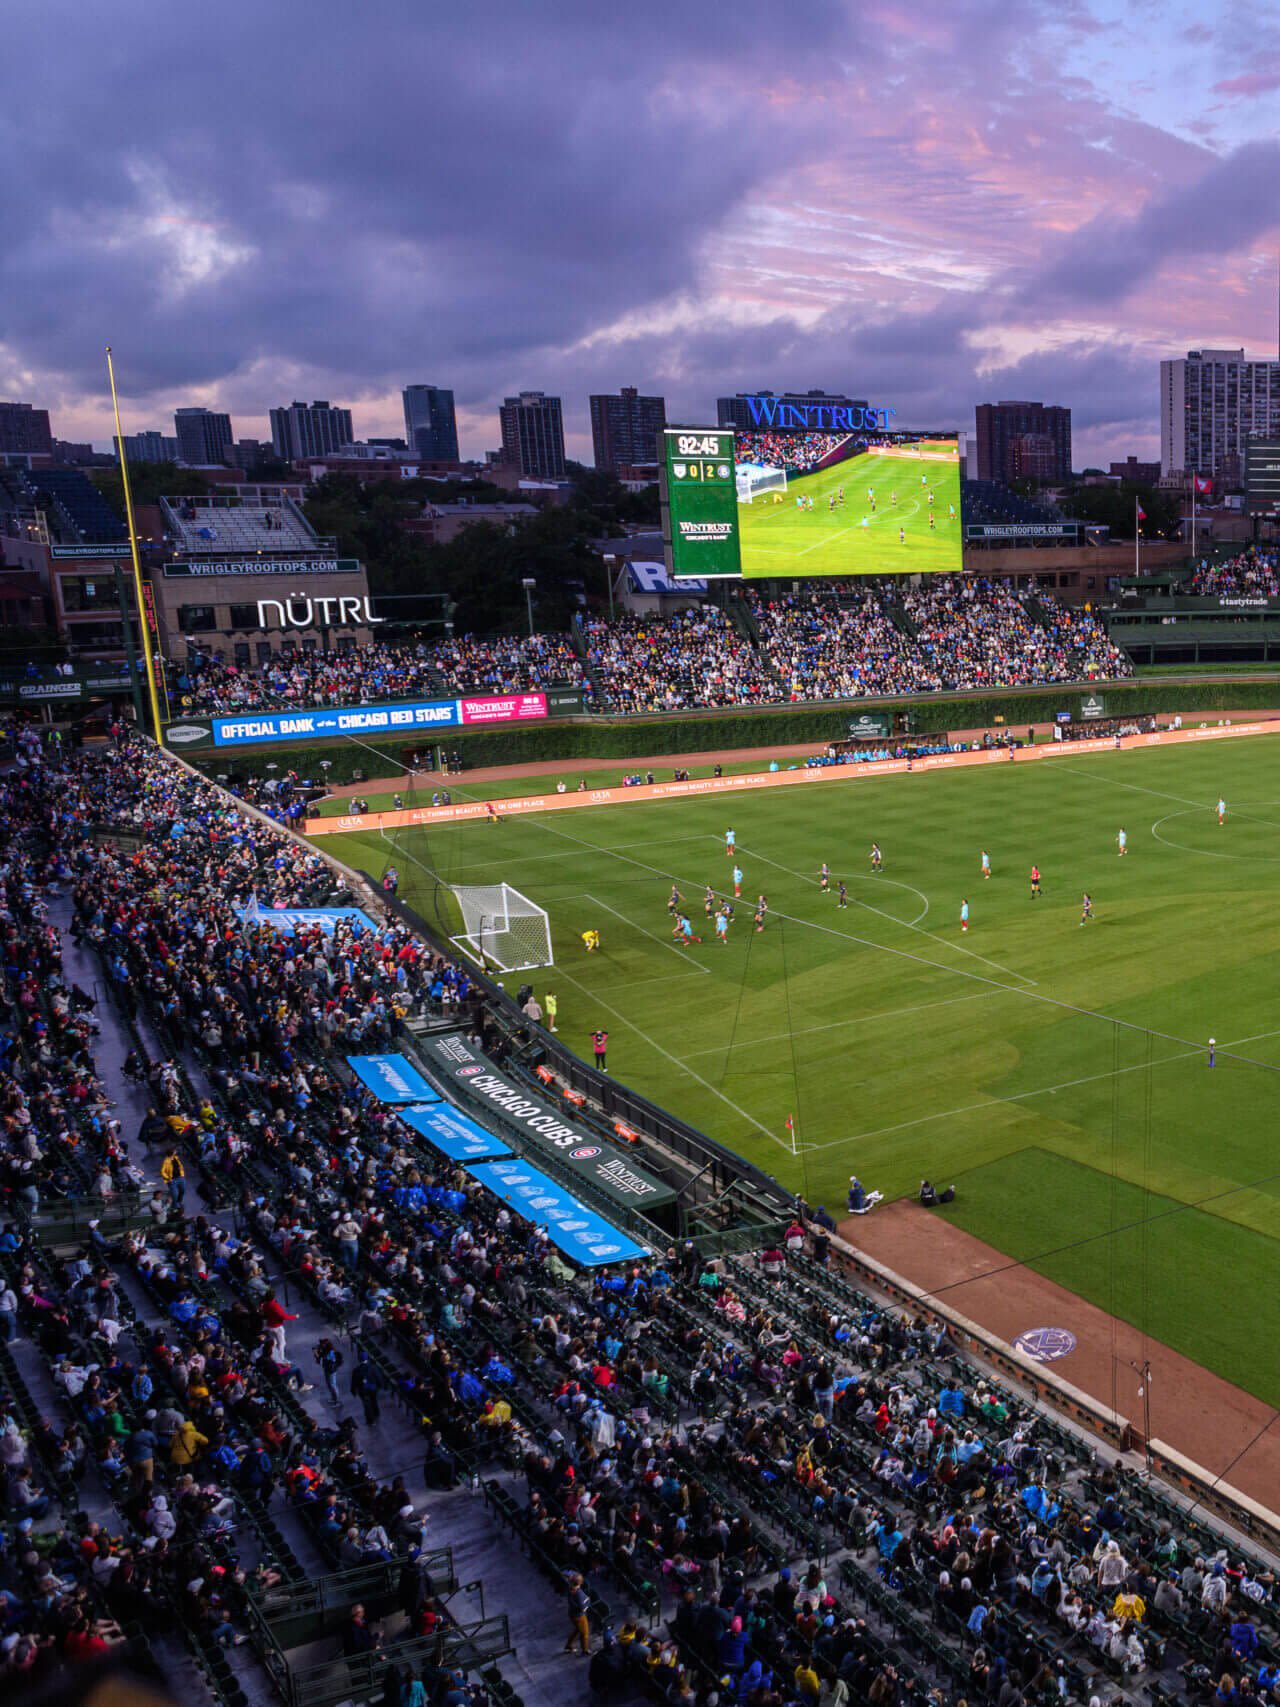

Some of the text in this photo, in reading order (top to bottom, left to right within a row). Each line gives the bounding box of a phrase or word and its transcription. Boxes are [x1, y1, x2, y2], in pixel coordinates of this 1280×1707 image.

[746, 396, 897, 431] WINTRUST
[678, 436, 719, 455] 92:45
[689, 465, 714, 478] 0 2
[679, 521, 732, 532] WINTRUST
[983, 526, 1063, 536] WRIGLEYROOFTOPS.COM
[188, 560, 339, 574] WRIGLEYROOFTOPS.COM
[1225, 598, 1268, 606] tastytrade
[20, 683, 81, 695] GRAINGER
[465, 701, 517, 713] WINTRUST
[221, 721, 278, 739] OFFICIAL
[280, 718, 315, 734] BANK
[338, 712, 388, 729] CHICAGO
[390, 711, 413, 724] RED
[416, 707, 453, 722] STARS
[666, 784, 688, 792] THINGS
[591, 791, 610, 801] ULTA
[507, 801, 522, 809] ONE
[426, 809, 454, 818] THINGS
[340, 818, 363, 828] ULTA
[469, 1075, 541, 1117] CHICAGO
[604, 1159, 656, 1194] WINTRUST
